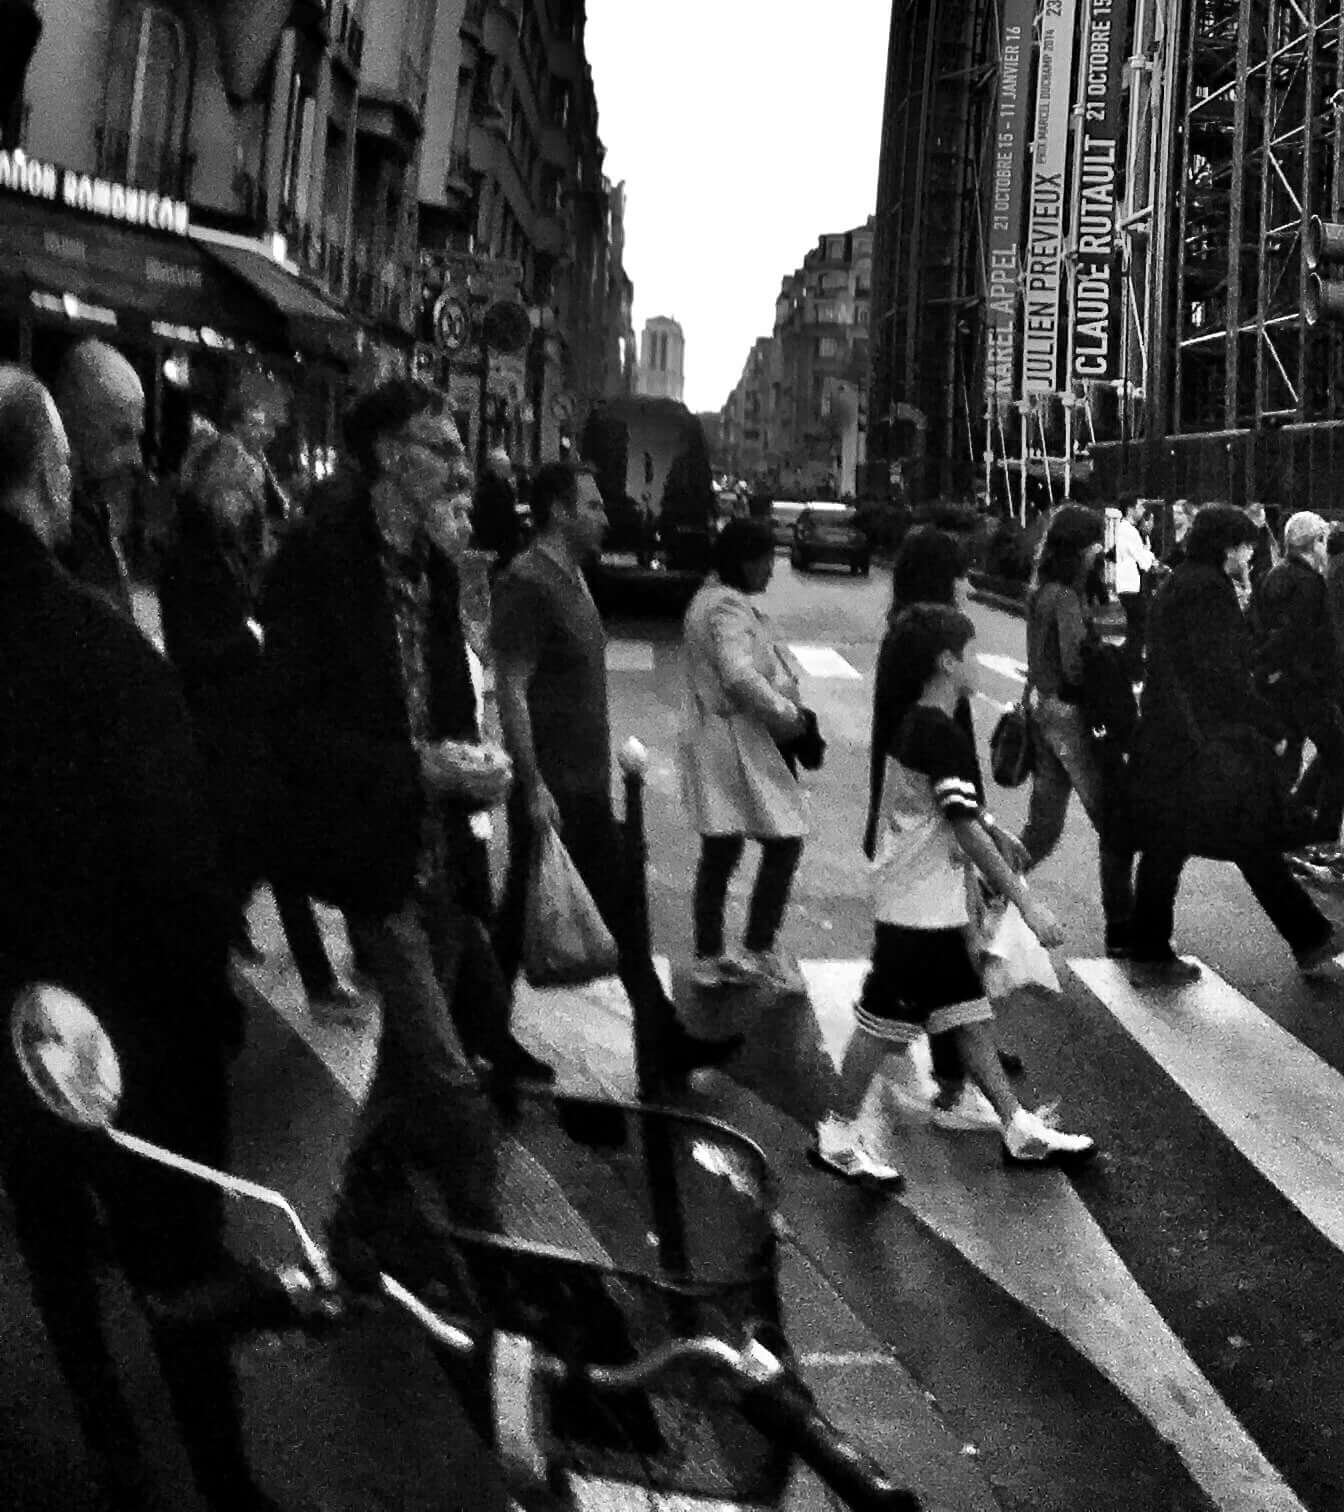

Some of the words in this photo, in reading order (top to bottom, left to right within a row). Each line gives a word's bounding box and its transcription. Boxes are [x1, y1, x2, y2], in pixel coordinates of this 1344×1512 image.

[1005, 25, 1021, 41] 16
[1046, 0, 1063, 17] 23
[1001, 45, 1020, 102] JANVIER
[1040, 53, 1054, 100] DUCHAMP
[1087, 19, 1111, 96] OCTOBRE
[1086, 99, 1106, 121] 21
[994, 152, 1013, 212] OCTOBRE
[1079, 134, 1117, 254] RUTAULT
[993, 215, 1009, 231] 21
[990, 242, 1017, 315] APPEL
[1026, 301, 1056, 388] JULIEN
[1075, 263, 1111, 375] CLAUDE
[984, 320, 1014, 393] KAREL
